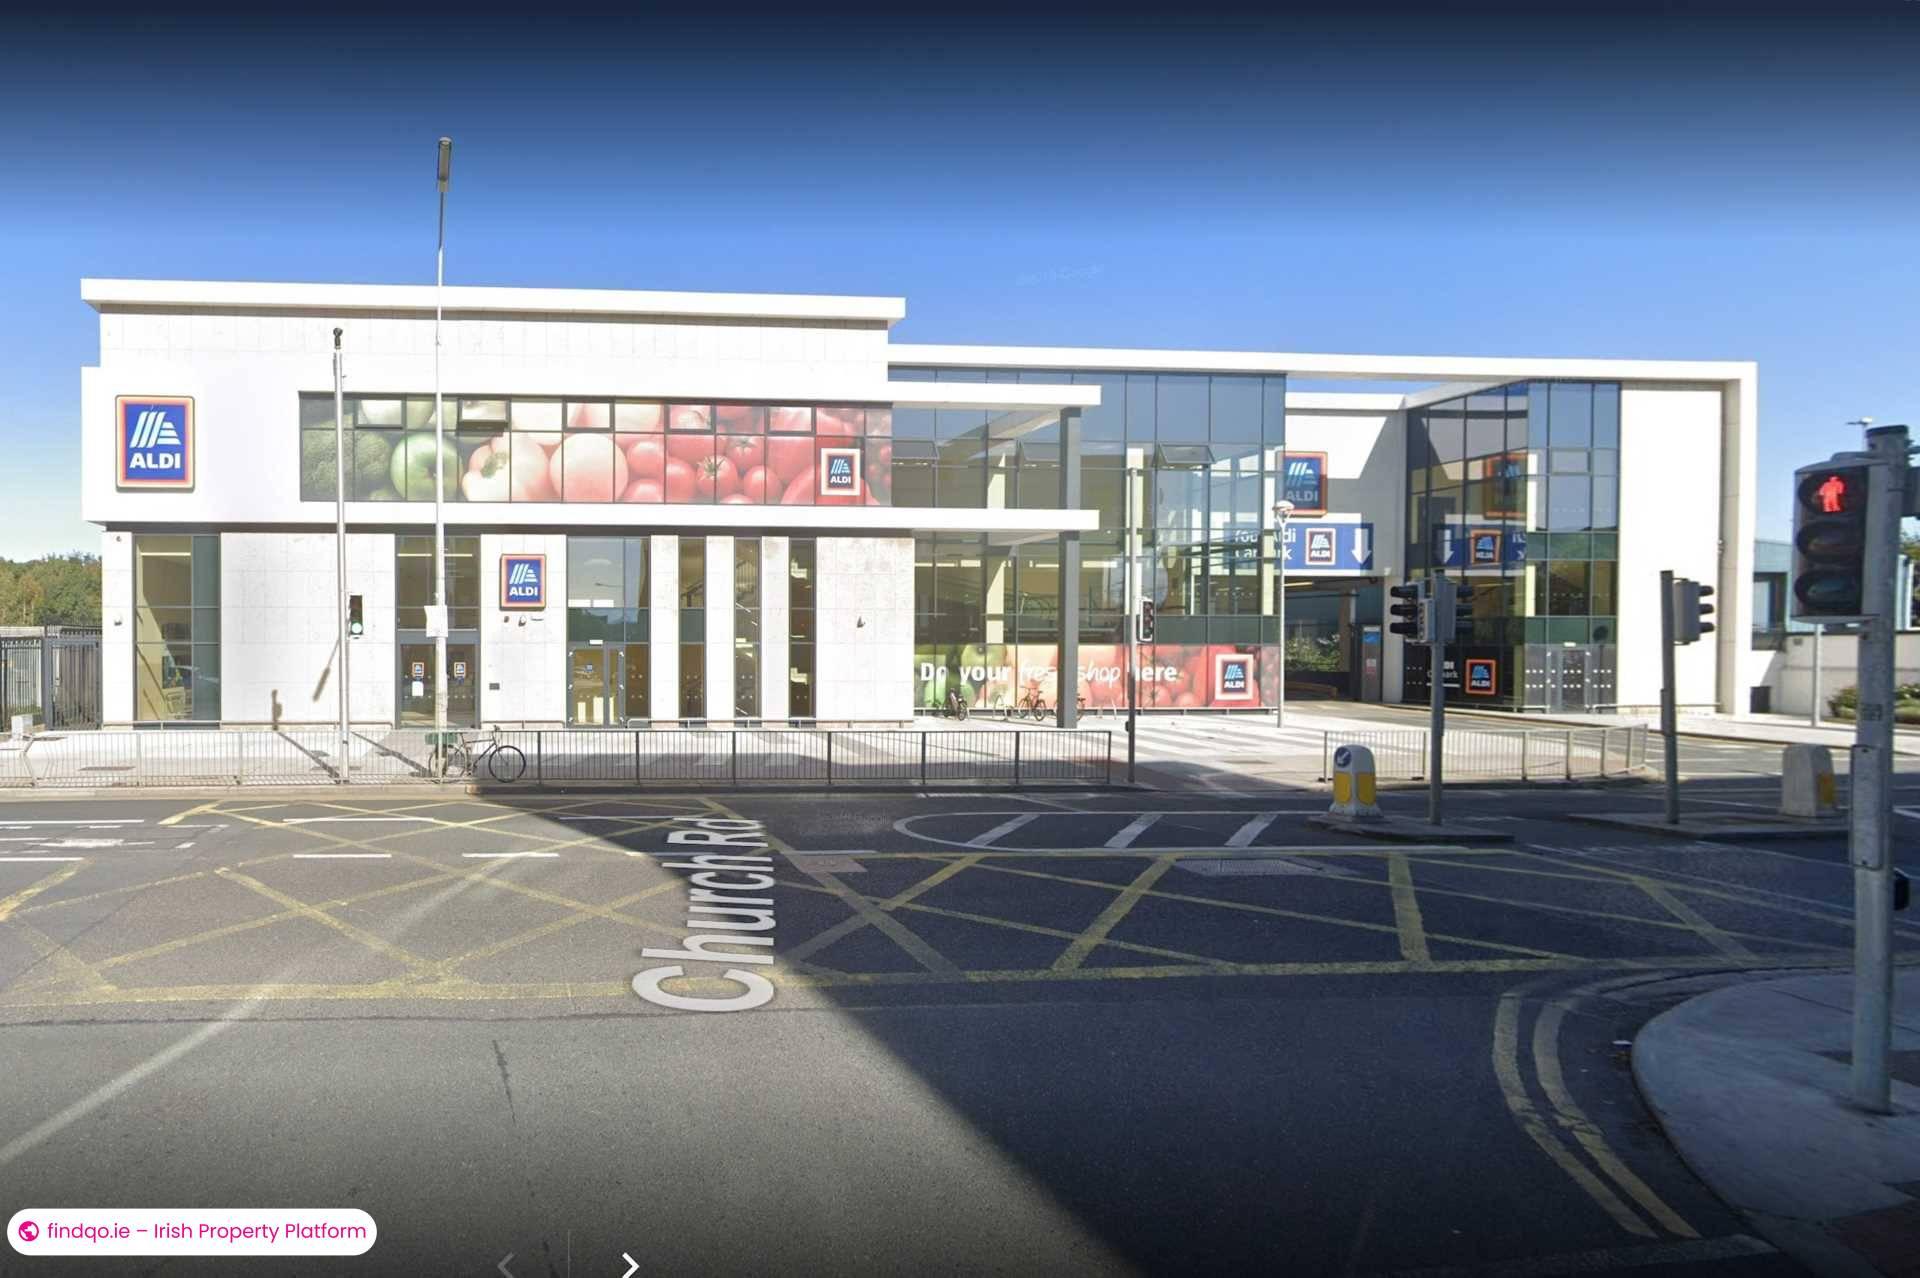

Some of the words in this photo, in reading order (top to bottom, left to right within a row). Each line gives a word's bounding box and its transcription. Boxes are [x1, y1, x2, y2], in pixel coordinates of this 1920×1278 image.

[129, 453, 181, 469] ALDI
[830, 476, 852, 484] ALDI
[1286, 490, 1319, 502] ALDI
[509, 587, 538, 597] ALDI
[921, 662, 948, 681] Do
[959, 665, 1012, 686] your
[1077, 660, 1121, 688] shop
[1224, 681, 1245, 689] ALDI
[1471, 680, 1491, 688] ALDI
